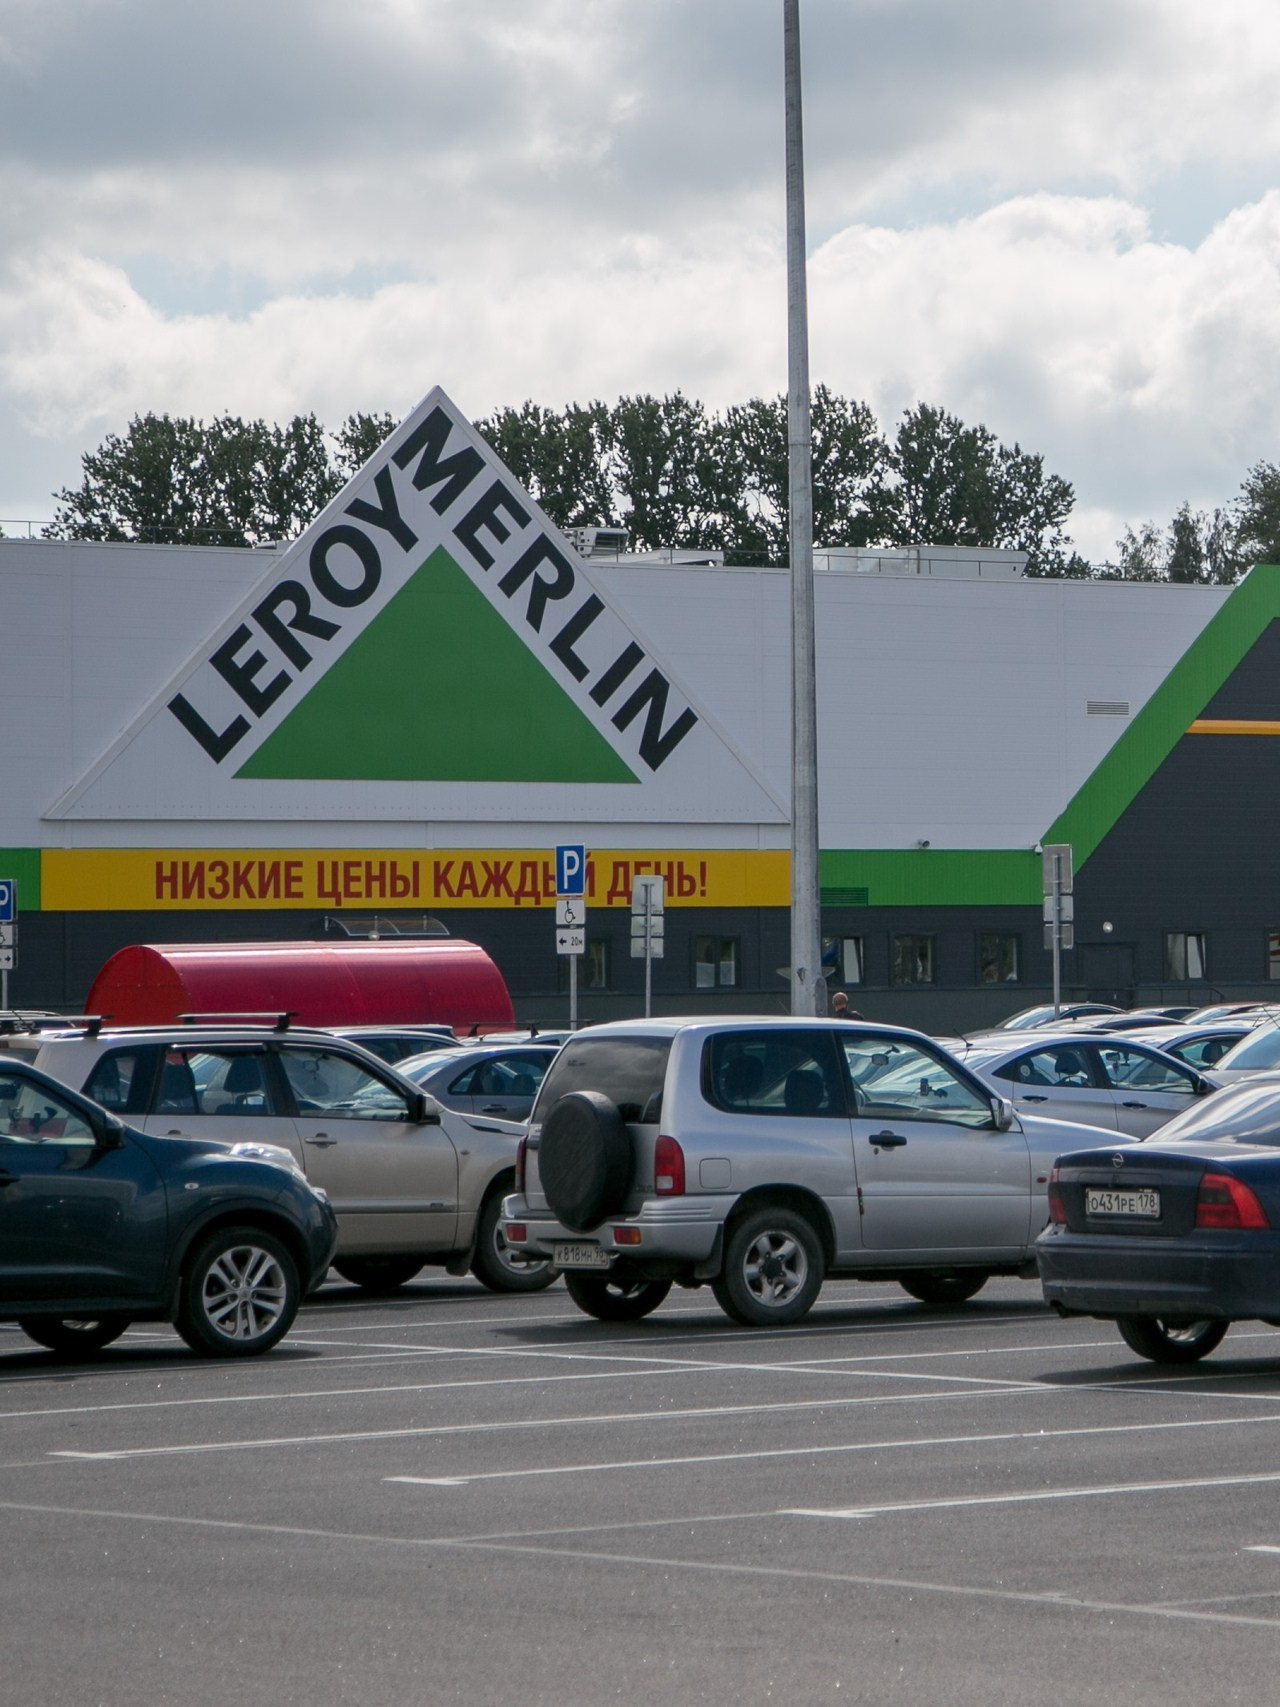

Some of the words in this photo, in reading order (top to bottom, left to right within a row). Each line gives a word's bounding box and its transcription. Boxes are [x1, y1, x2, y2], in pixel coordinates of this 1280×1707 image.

[391, 406, 699, 772] MERLIN
[167, 464, 419, 765] LEROY
[155, 861, 304, 899] НИЗКИЕ
[317, 861, 420, 907] ЦЕНЫ
[563, 850, 580, 890] P
[1138, 1194, 1155, 1208] 178
